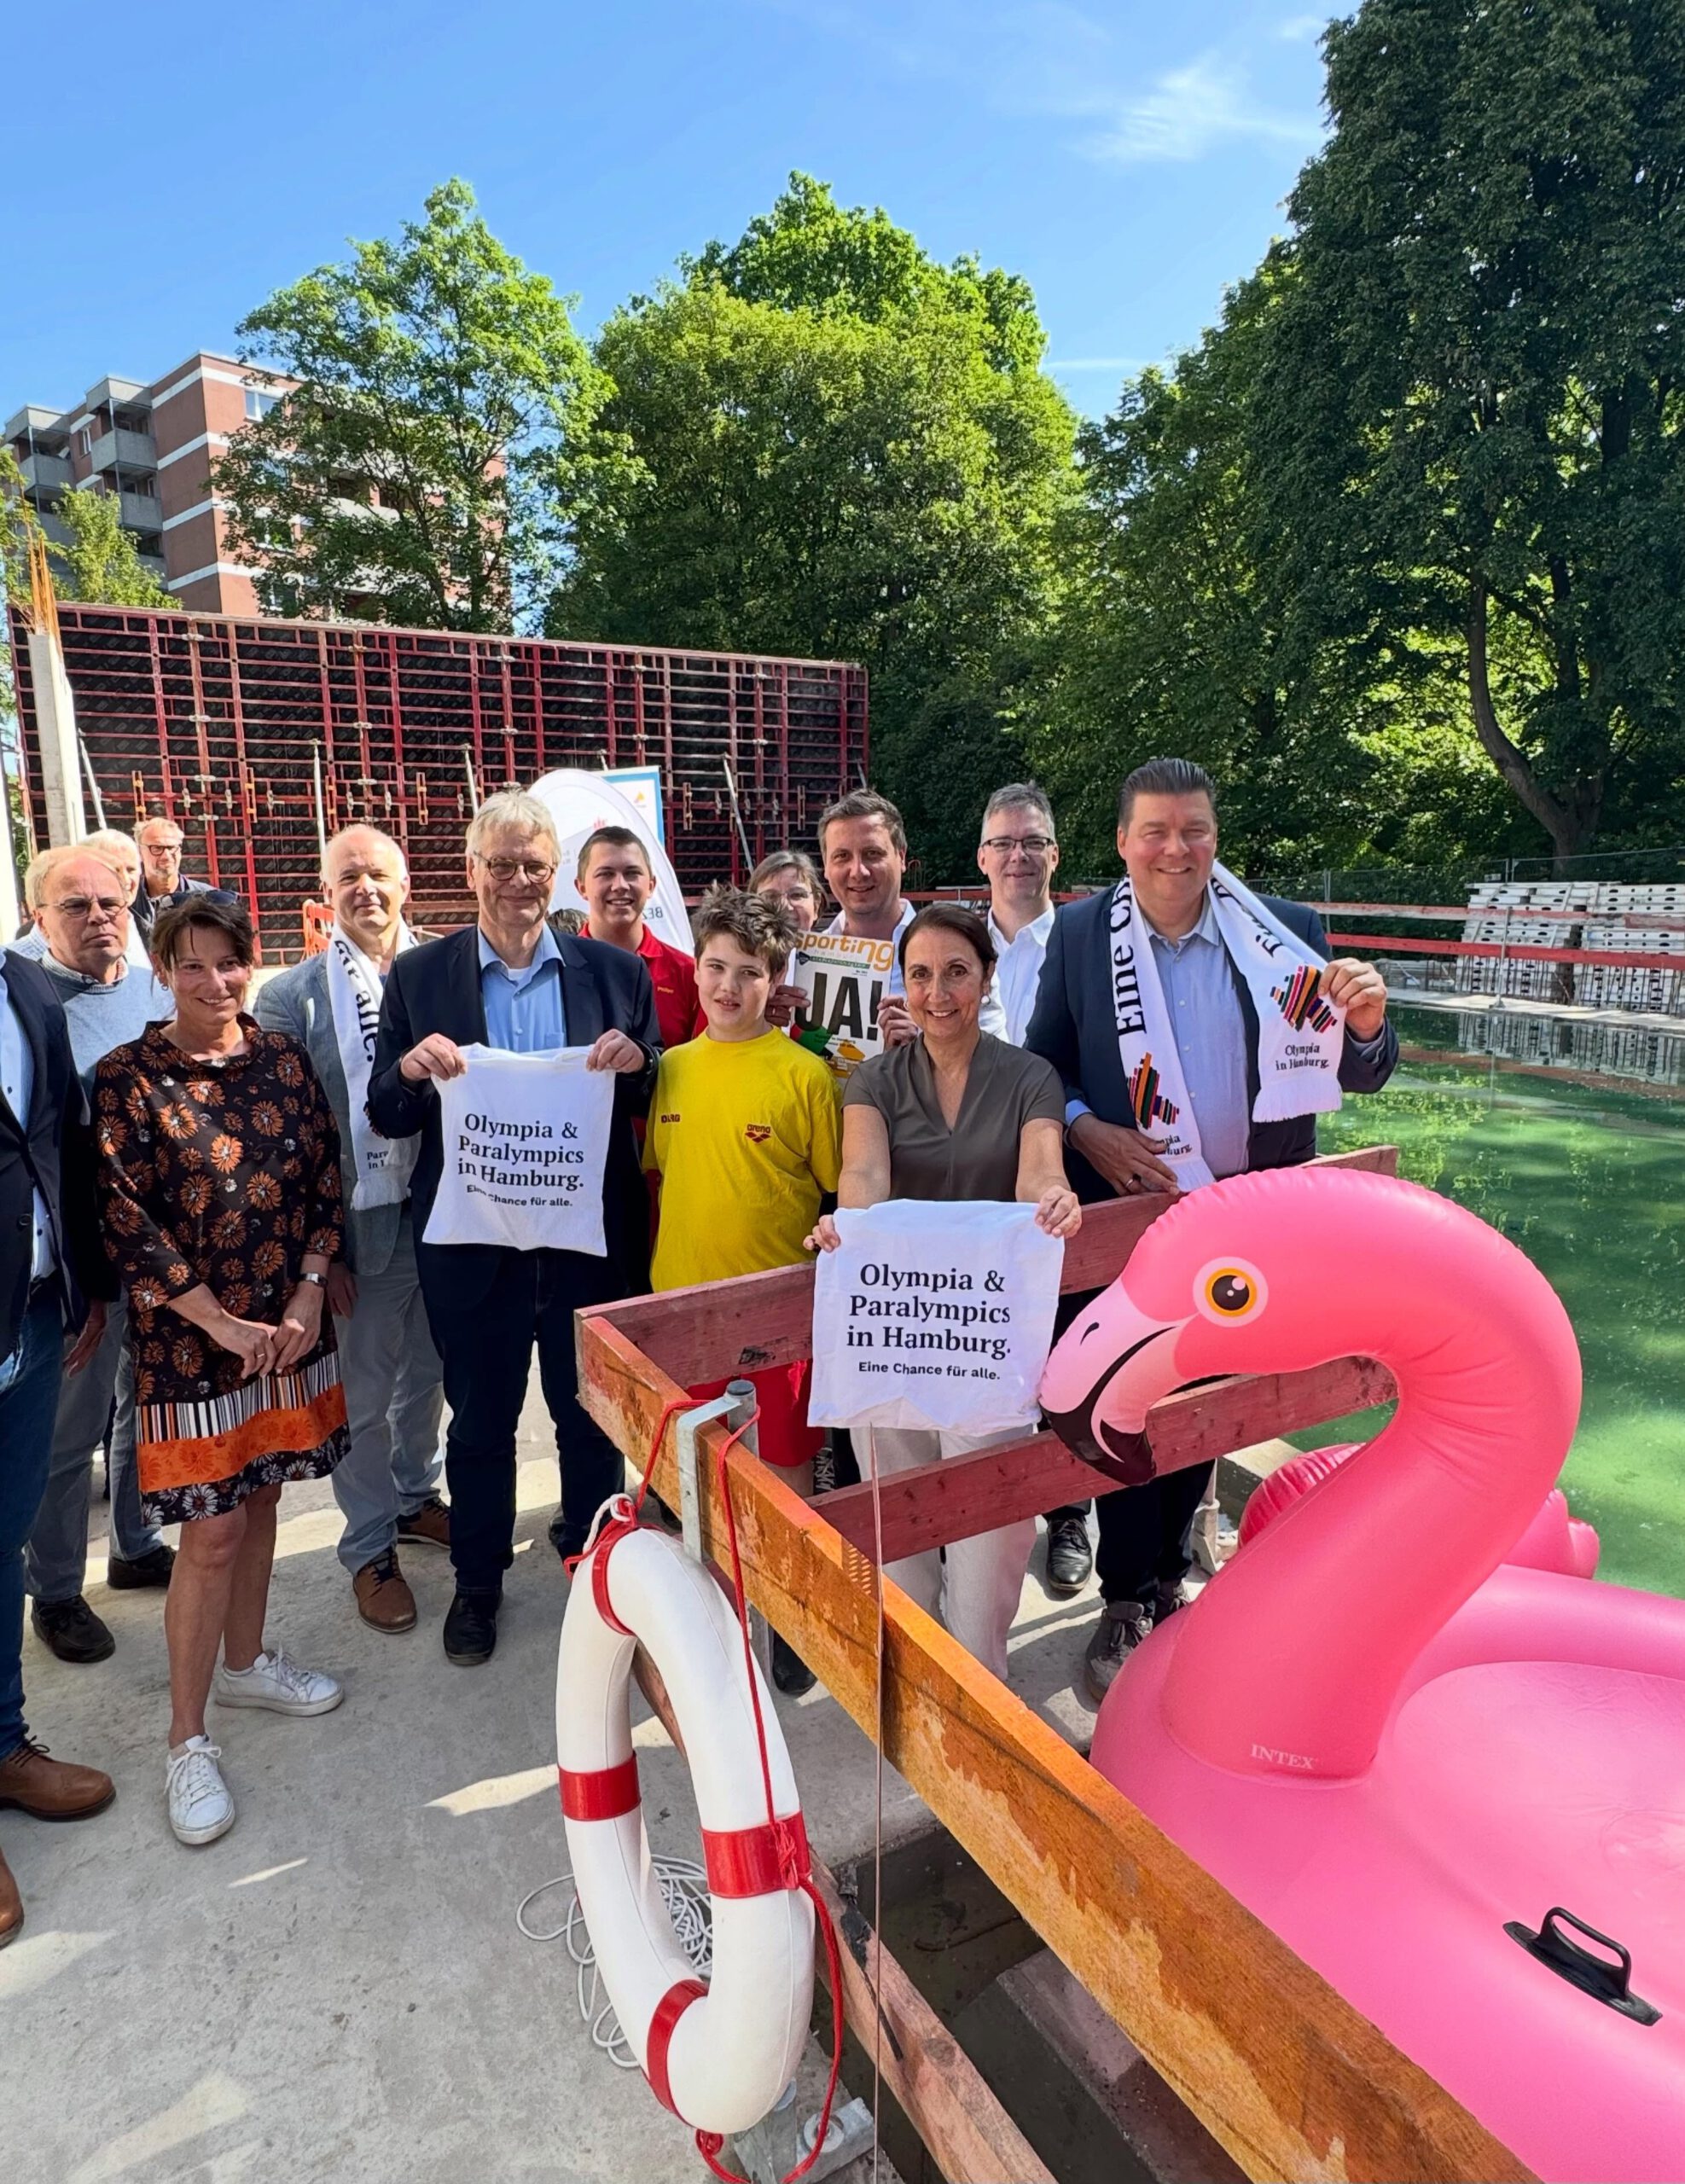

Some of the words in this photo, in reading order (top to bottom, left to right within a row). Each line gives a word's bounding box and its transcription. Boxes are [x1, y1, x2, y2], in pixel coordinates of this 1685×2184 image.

[795, 932, 894, 972] sporting
[794, 972, 883, 1041] JA!
[1285, 1043, 1320, 1056] Olympia
[1275, 1060, 1287, 1071] in
[464, 1112, 553, 1141] Olympia
[561, 1122, 578, 1139] &
[747, 1124, 771, 1134] arena
[458, 1136, 584, 1165] Paralympics
[458, 1158, 477, 1176] in
[481, 1166, 585, 1191] Hamburg.
[530, 1197, 547, 1206] für
[549, 1197, 573, 1206] alle.
[860, 1263, 973, 1292] Olympia
[984, 1270, 1005, 1292] &
[849, 1295, 1011, 1327] Paralympics
[846, 1325, 873, 1347] in
[882, 1326, 1011, 1361] Hamburg.
[858, 1361, 889, 1373] Eine
[893, 1362, 943, 1375] Chance
[946, 1363, 967, 1377] für
[971, 1368, 1000, 1380] alle.
[1250, 1744, 1316, 1770] INTEX
